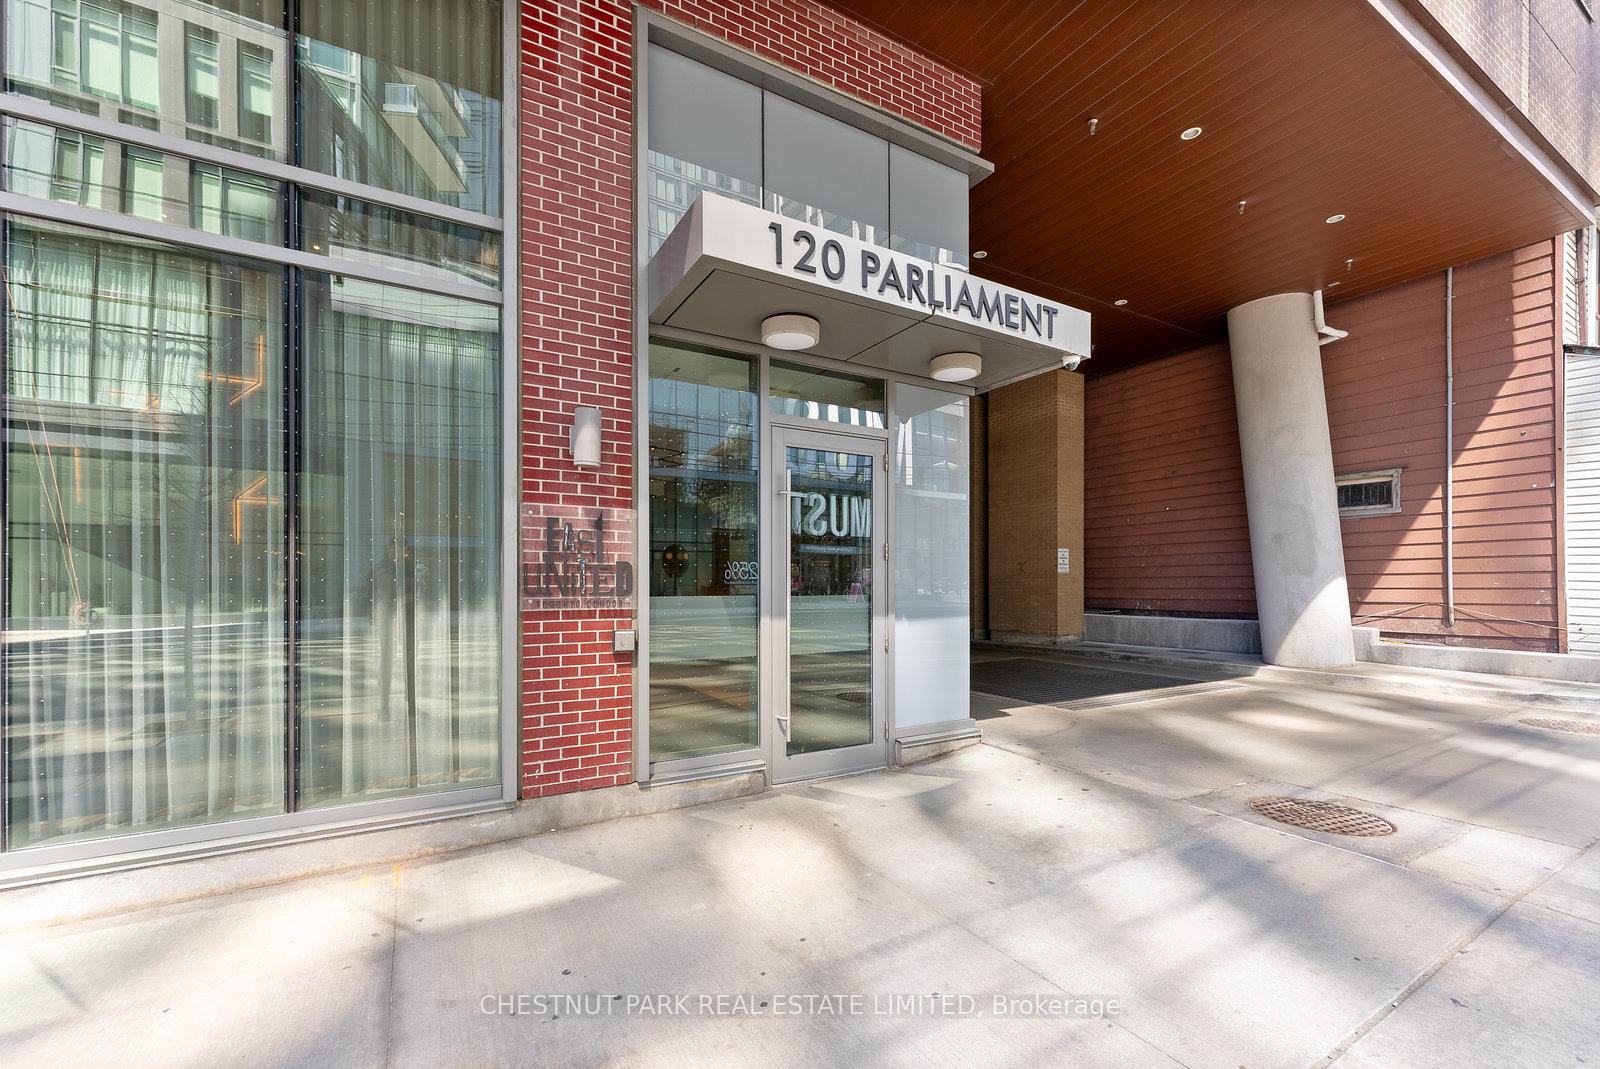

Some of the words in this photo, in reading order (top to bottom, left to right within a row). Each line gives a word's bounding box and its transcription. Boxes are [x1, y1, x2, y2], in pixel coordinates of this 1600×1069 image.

[768, 221, 846, 281] 120
[861, 249, 1059, 339] PARLIAMENT
[537, 600, 580, 609] TORONTO
[586, 600, 623, 609] CONDOS
